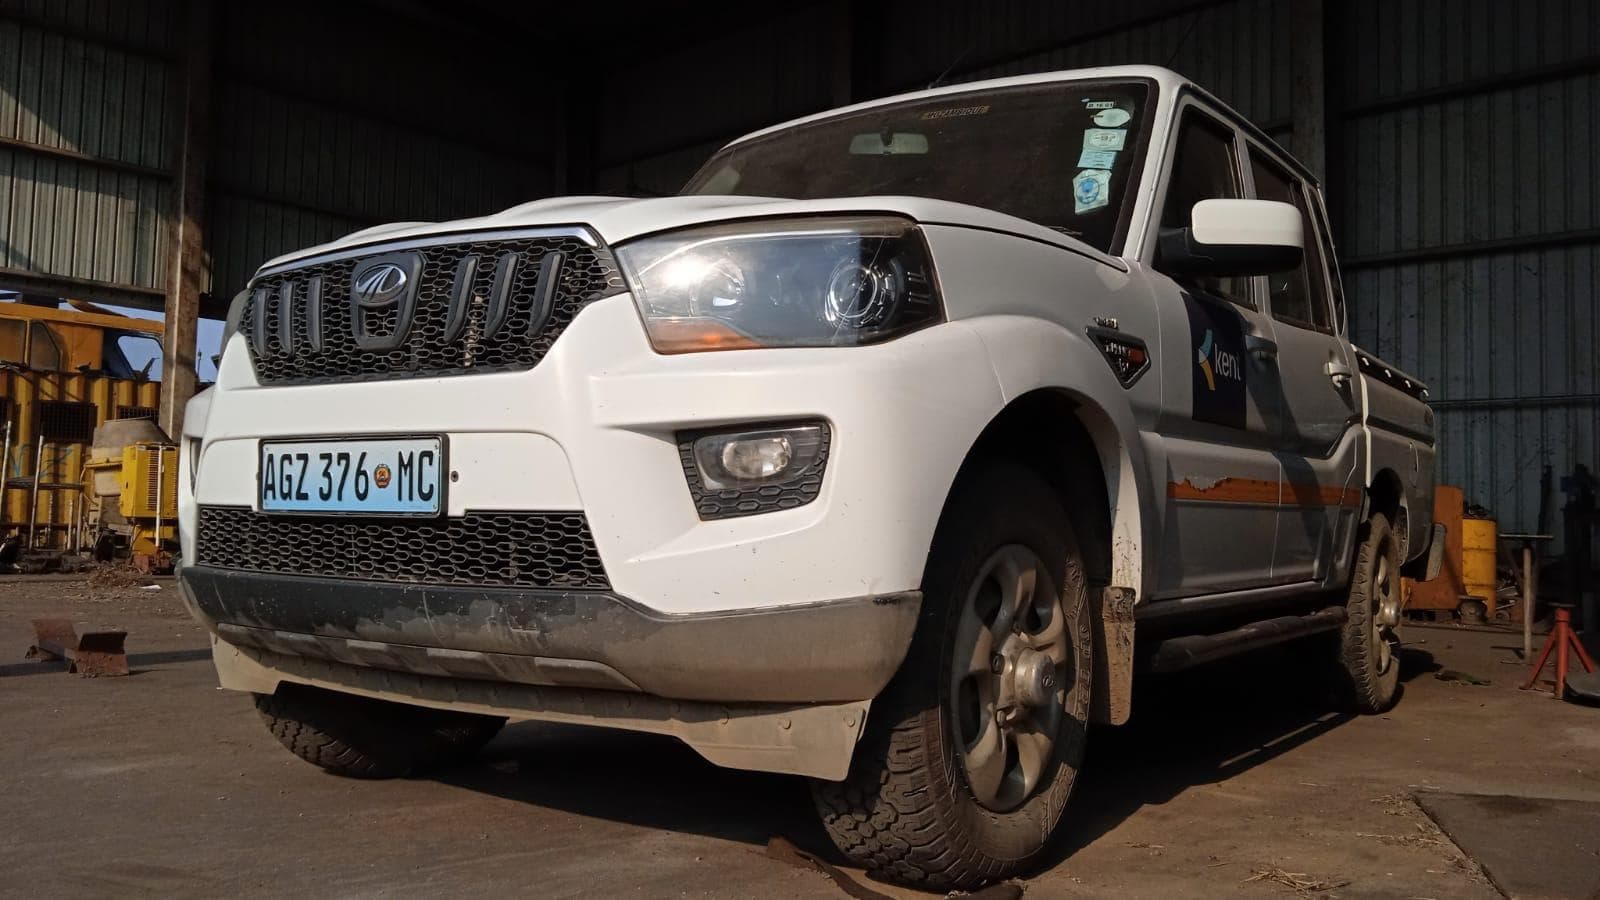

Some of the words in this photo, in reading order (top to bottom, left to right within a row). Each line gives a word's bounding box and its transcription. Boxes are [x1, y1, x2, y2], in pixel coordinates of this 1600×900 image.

[1214, 343, 1241, 381] kent
[263, 453, 309, 501] AGZ
[318, 451, 369, 501] 376
[397, 450, 434, 502] MC
